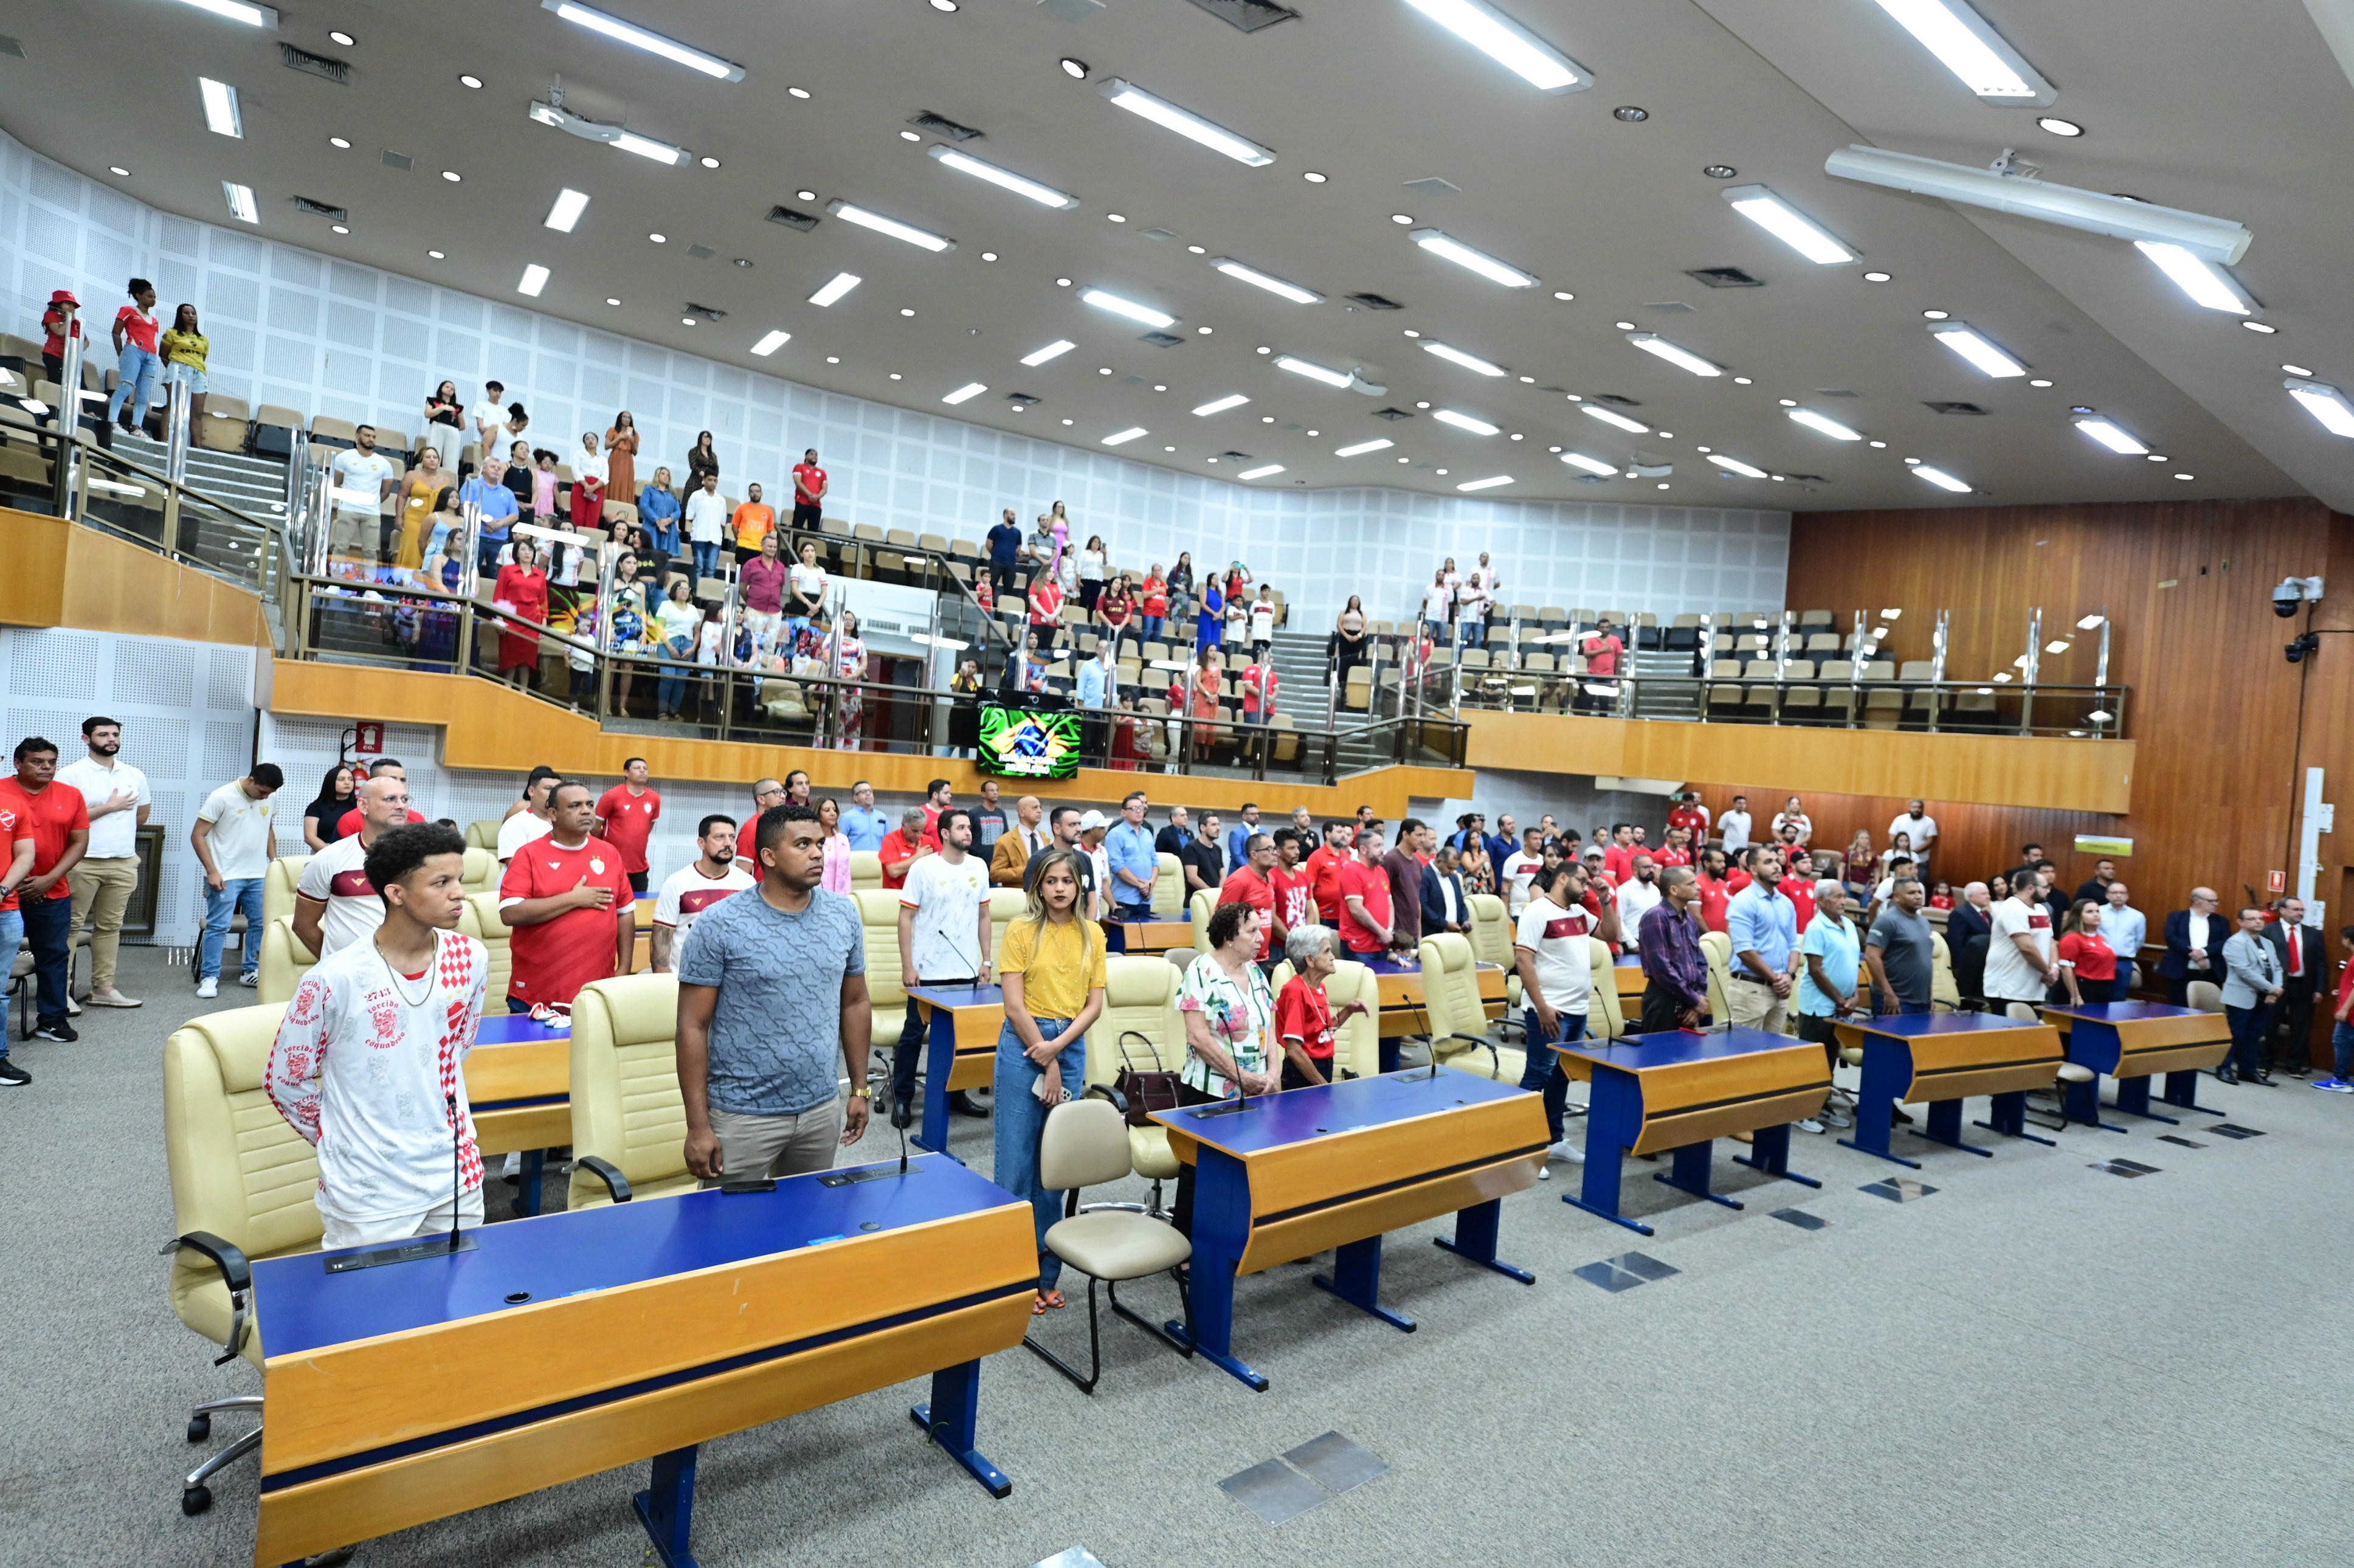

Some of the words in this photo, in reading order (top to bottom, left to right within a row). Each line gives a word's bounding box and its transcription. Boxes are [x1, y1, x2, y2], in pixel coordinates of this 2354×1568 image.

[1021, 754, 1058, 765] NACIONAL
[1005, 762, 1050, 775] BRASILEIRO
[364, 987, 391, 1002] 2743
[368, 1000, 399, 1014] torcida
[284, 1045, 314, 1054] torcida
